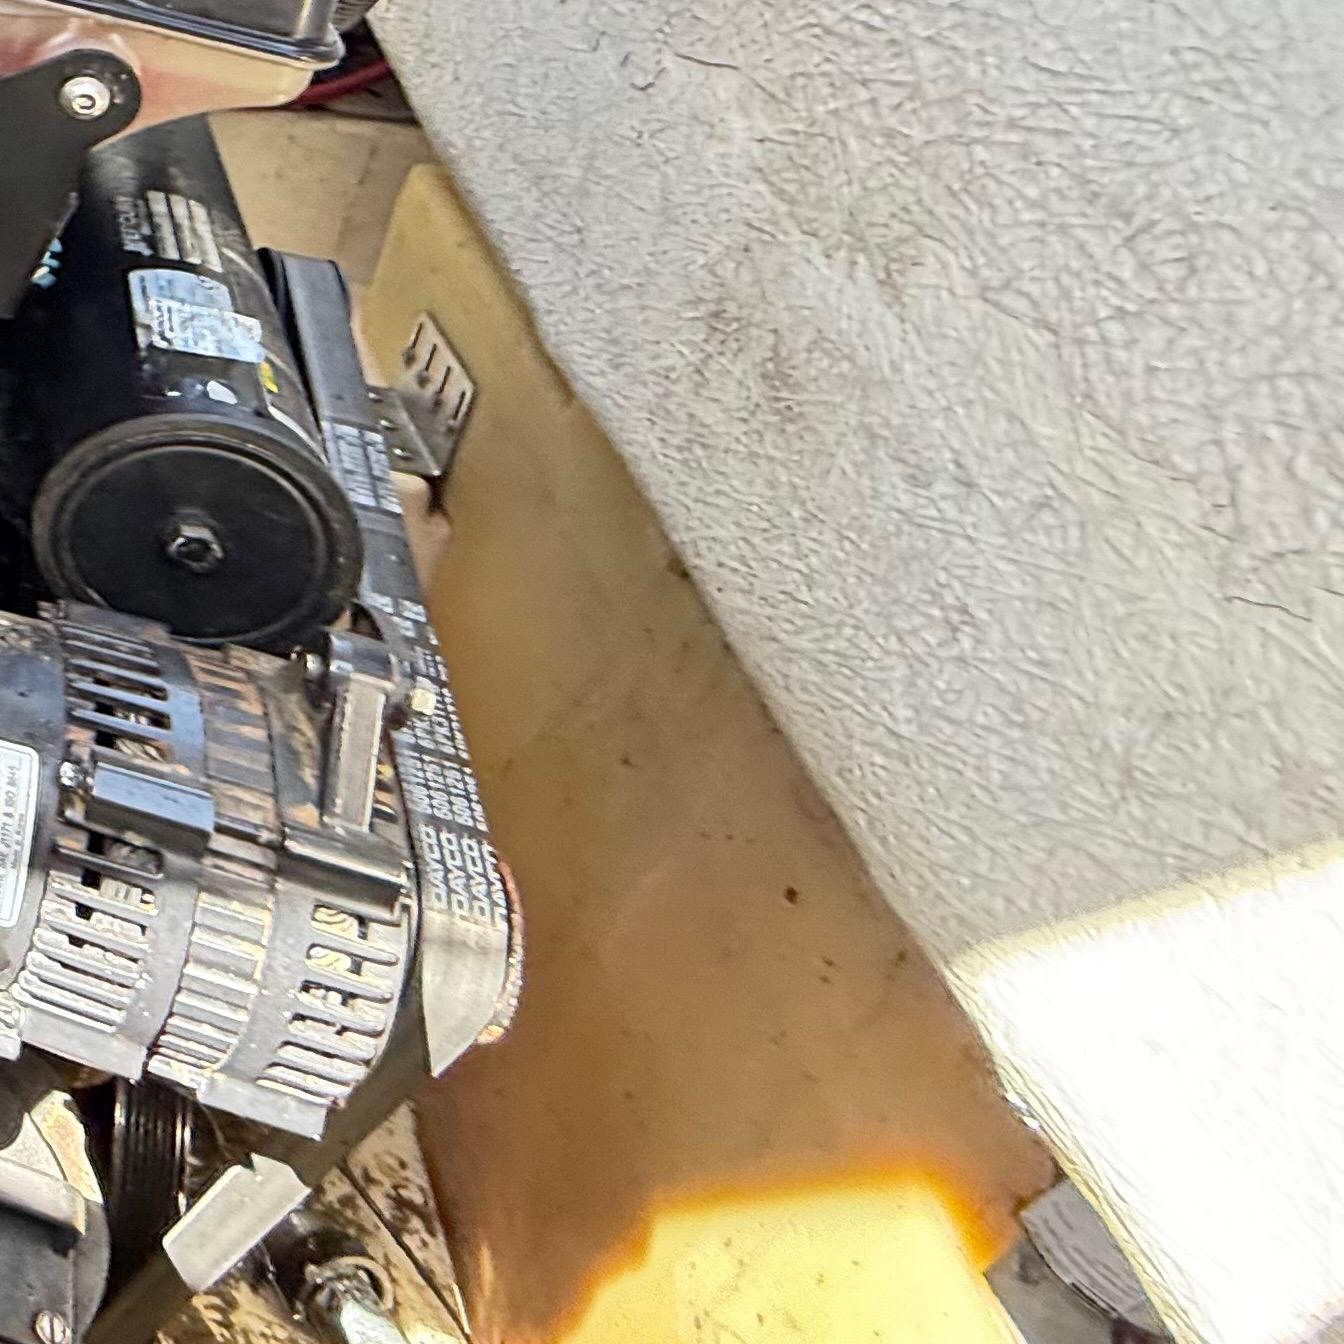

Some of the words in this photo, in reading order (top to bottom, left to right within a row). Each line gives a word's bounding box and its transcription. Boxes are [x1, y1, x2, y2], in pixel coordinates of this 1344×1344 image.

[419, 823, 449, 912] DAYCO
[439, 828, 471, 918] DAYCO
[460, 834, 492, 925] DAYCO
